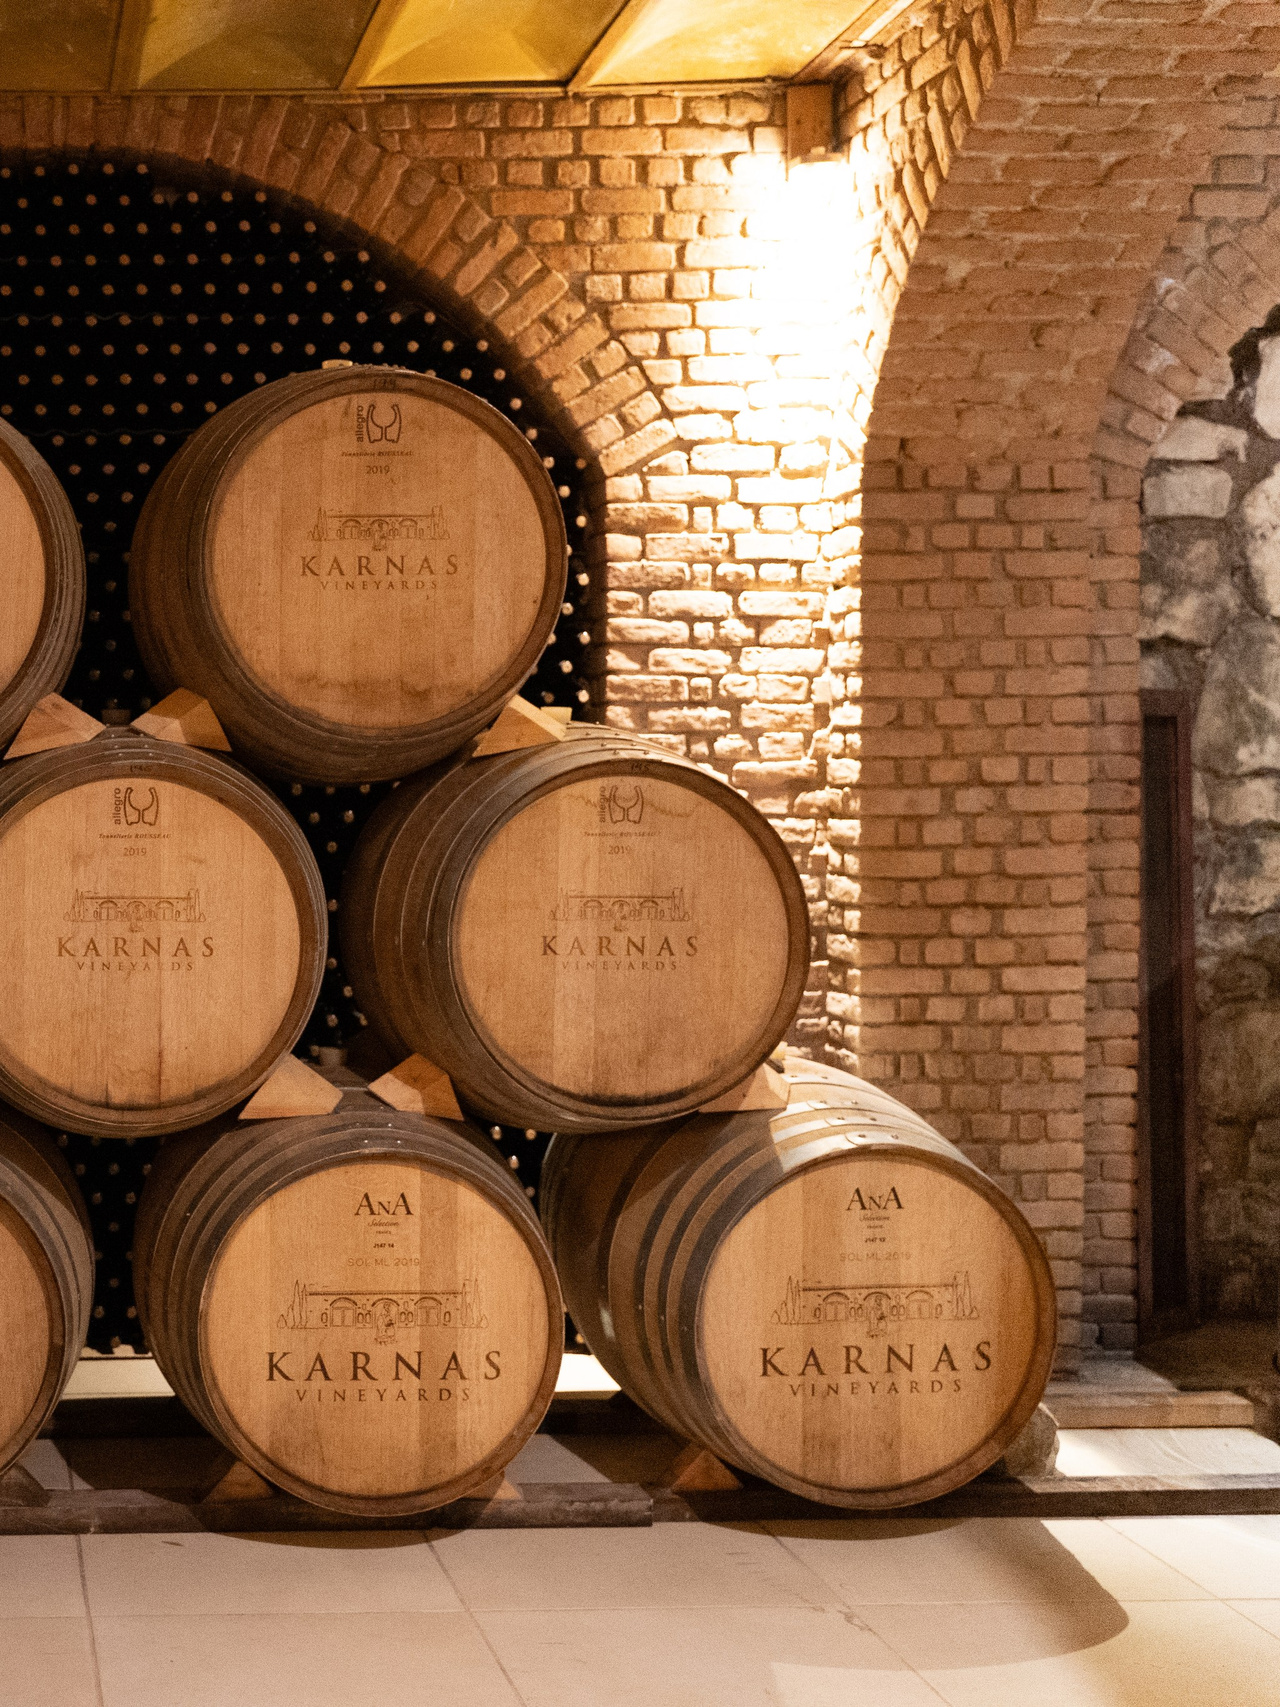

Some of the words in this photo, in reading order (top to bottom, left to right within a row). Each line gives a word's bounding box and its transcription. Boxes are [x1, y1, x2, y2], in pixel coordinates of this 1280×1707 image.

[355, 405, 366, 442] allegro
[365, 465, 391, 475] 2019
[300, 554, 458, 577] KARNAS
[320, 580, 437, 591] VINEYARDS
[112, 787, 124, 825] allegro
[123, 848, 147, 857] 2019
[57, 936, 214, 957] KARNAS
[542, 935, 698, 956] KARNAS
[562, 961, 677, 971] VINEYARDS
[393, 1257, 420, 1267] 2019
[266, 1351, 502, 1382] KARNAS
[760, 1341, 992, 1377] KARNAS
[296, 1388, 471, 1402] VINEYARDS
[789, 1379, 962, 1397] VINEYARDS
